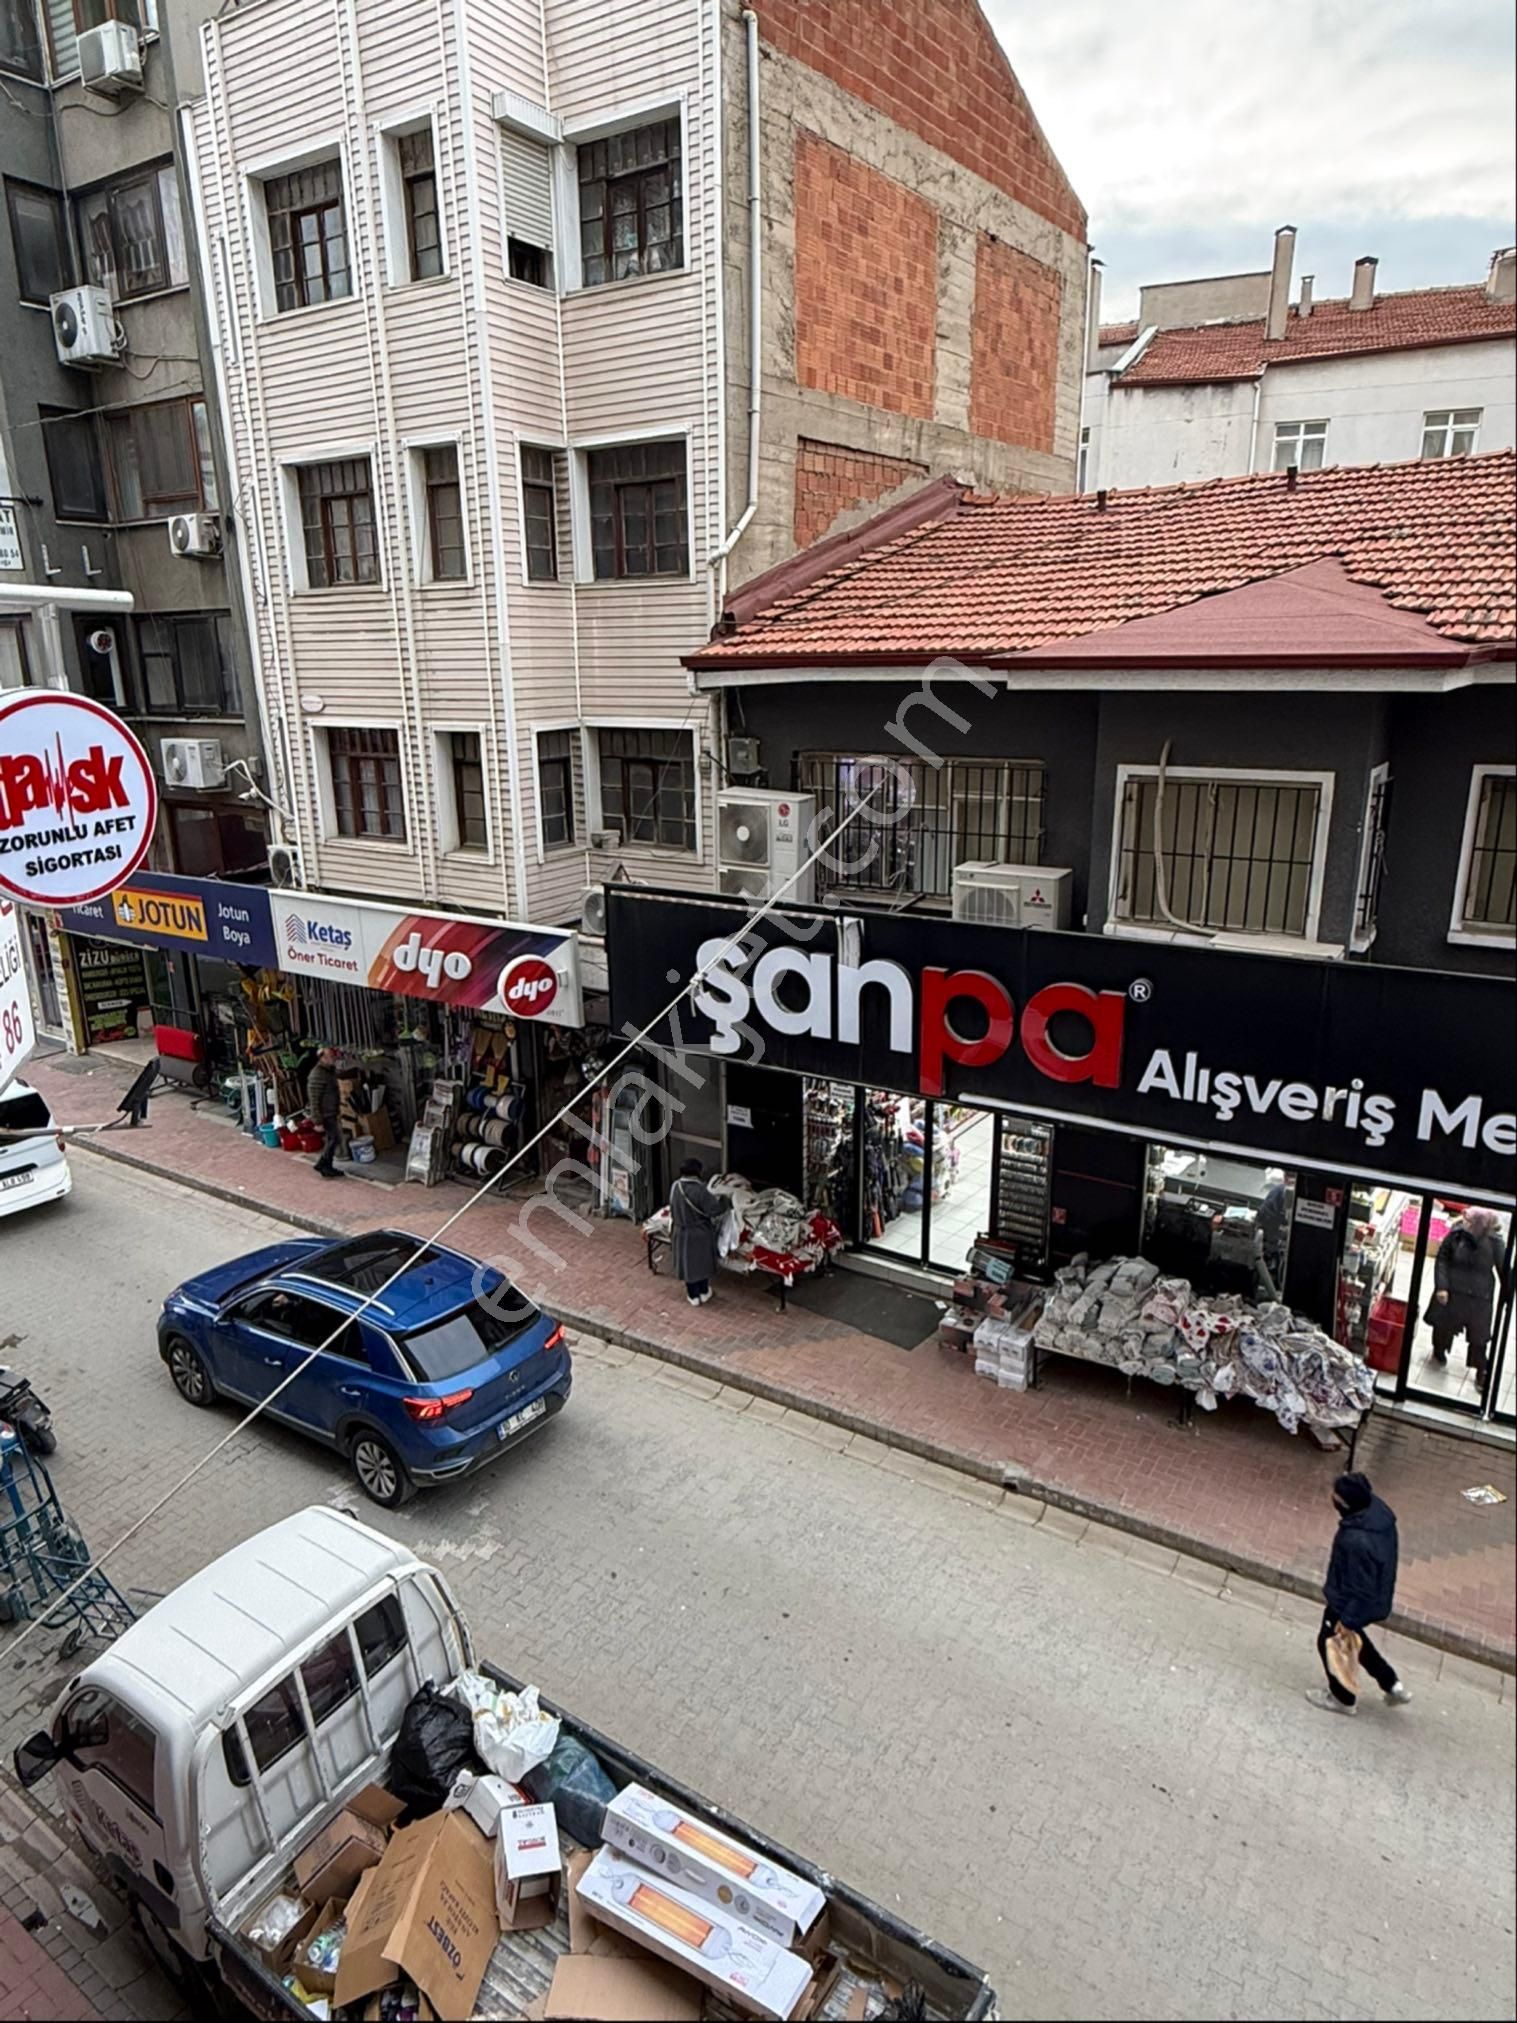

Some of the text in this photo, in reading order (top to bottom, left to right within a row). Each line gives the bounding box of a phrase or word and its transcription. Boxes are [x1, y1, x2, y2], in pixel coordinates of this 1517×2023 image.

[0, 815, 136, 855] ZORUNLU AFET
[25, 844, 122, 877] SİGORTASI
[138, 899, 203, 933] JOTUN
[218, 902, 250, 923] Jotun
[223, 926, 251, 947] Boya
[307, 920, 353, 951] Ketaş
[287, 944, 315, 963] Öner
[317, 953, 359, 972] Ticaret
[393, 932, 473, 989] dyo
[508, 977, 553, 1002] dyo
[1137, 1048, 1397, 1147] Alışveriş
